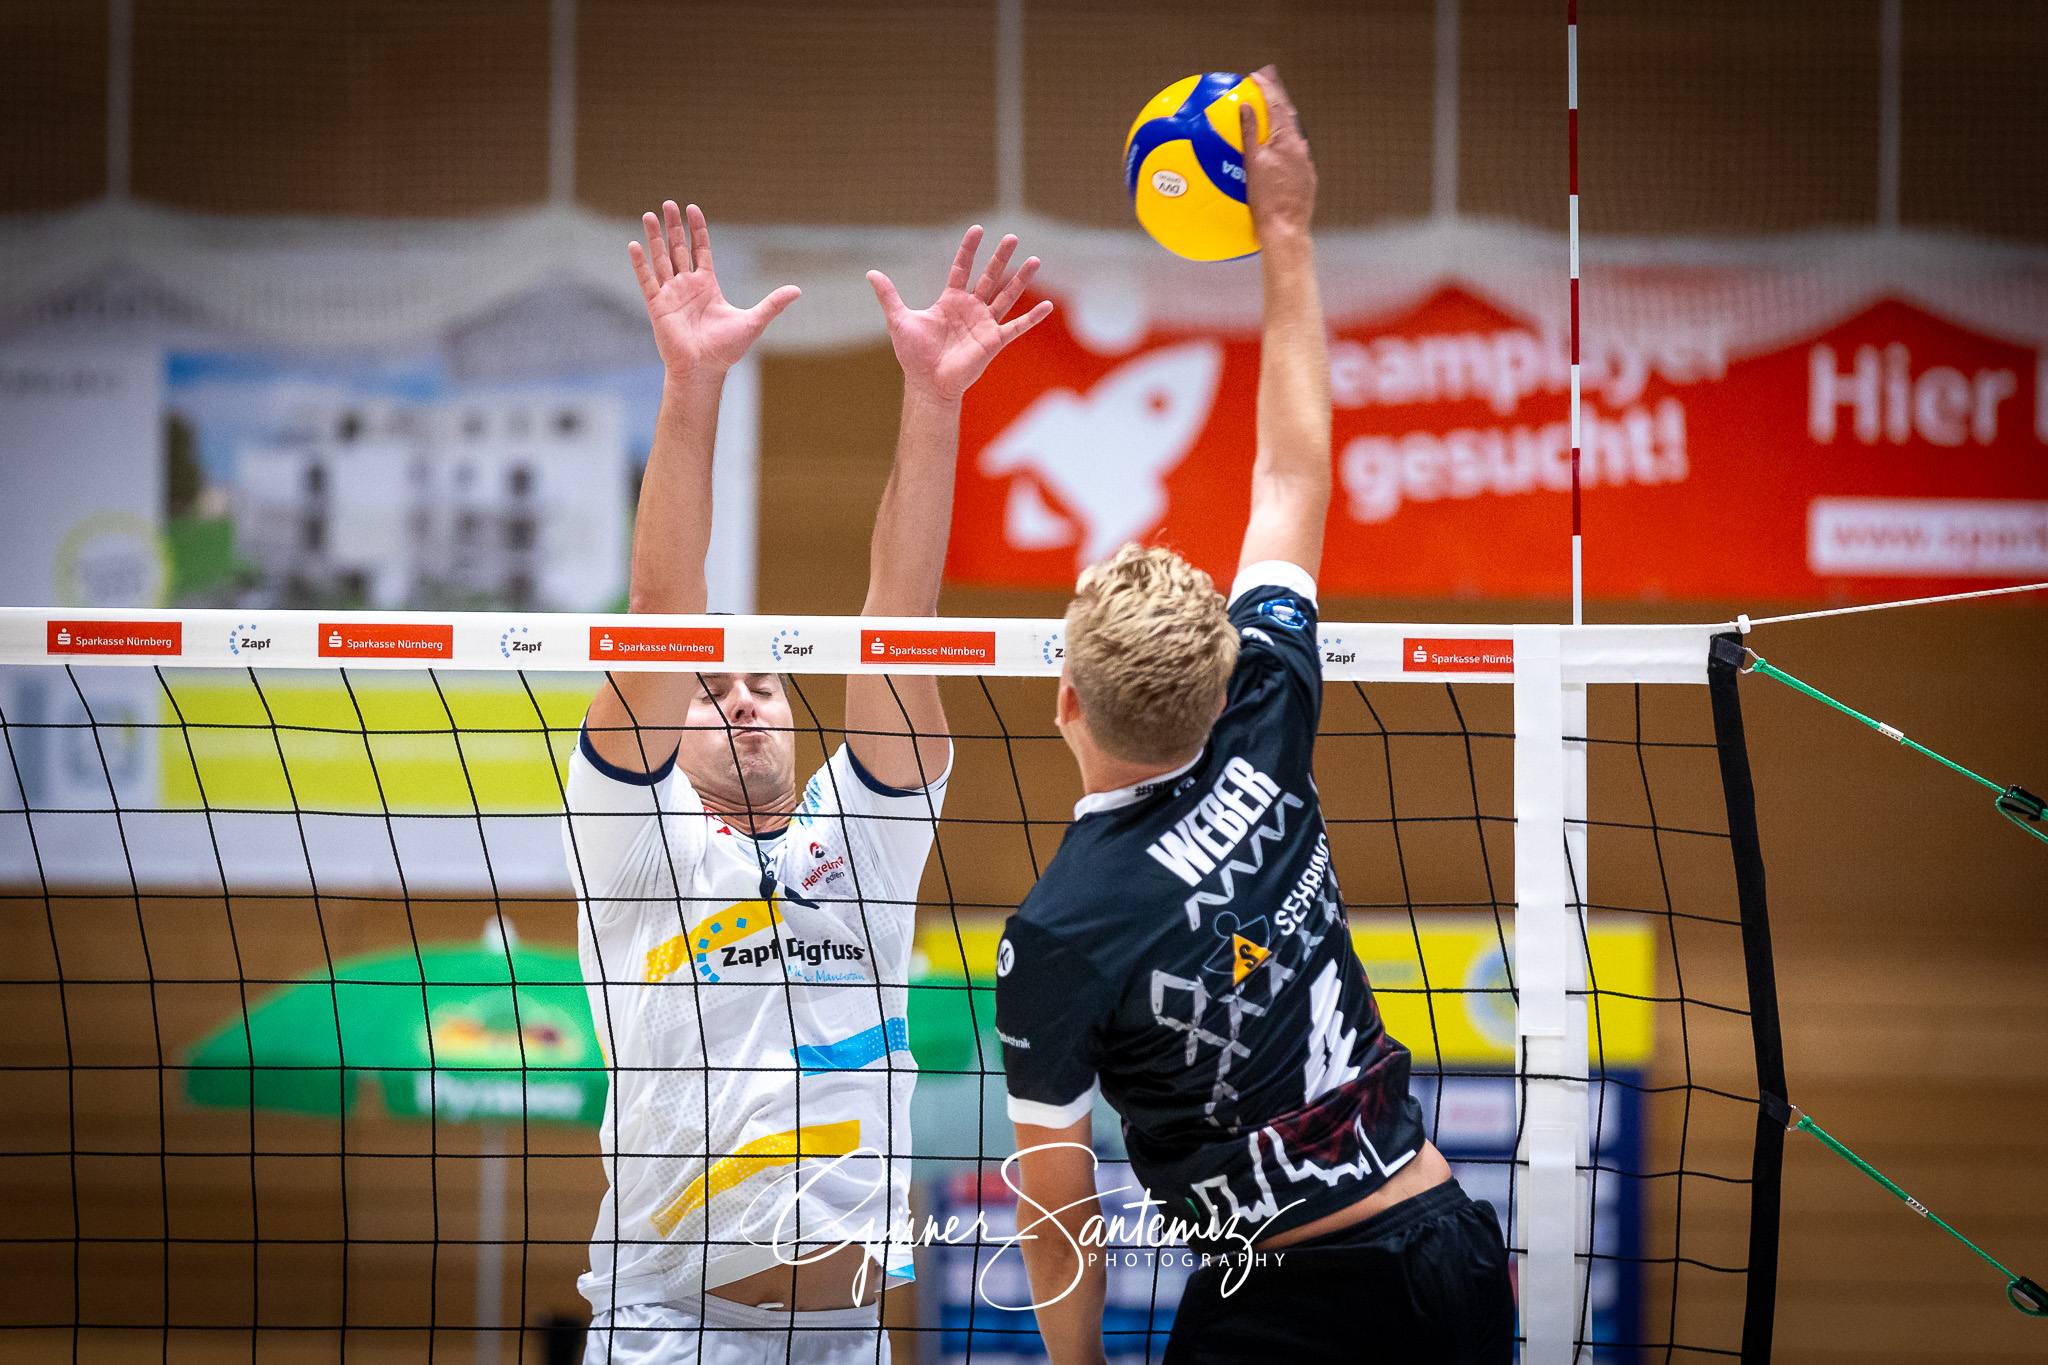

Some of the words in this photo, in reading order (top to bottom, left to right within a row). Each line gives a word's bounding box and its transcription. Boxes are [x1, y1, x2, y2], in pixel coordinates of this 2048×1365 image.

[1330, 315, 1726, 414] eamplayer
[1807, 341, 2016, 446] Hier
[1341, 397, 1690, 523] gesucht!
[75, 636, 125, 648] Sparkasse
[126, 636, 172, 649] Nürnberg
[241, 638, 271, 651] Zapf
[346, 638, 396, 651] Sparkasse
[397, 639, 443, 652] Nürnberg
[512, 641, 542, 654] Zapf
[617, 642, 667, 655] Sparkasse
[668, 642, 715, 655] Nürnberg
[783, 644, 814, 657] Zapf
[889, 645, 938, 658] Sparkasse
[940, 645, 986, 659] Nürnberg
[1326, 652, 1356, 665] Zapf
[1431, 653, 1481, 665] Sparkasse
[1482, 653, 1514, 665] Nürnb
[1145, 756, 1282, 888] WEBER
[720, 938, 780, 967] Zapf
